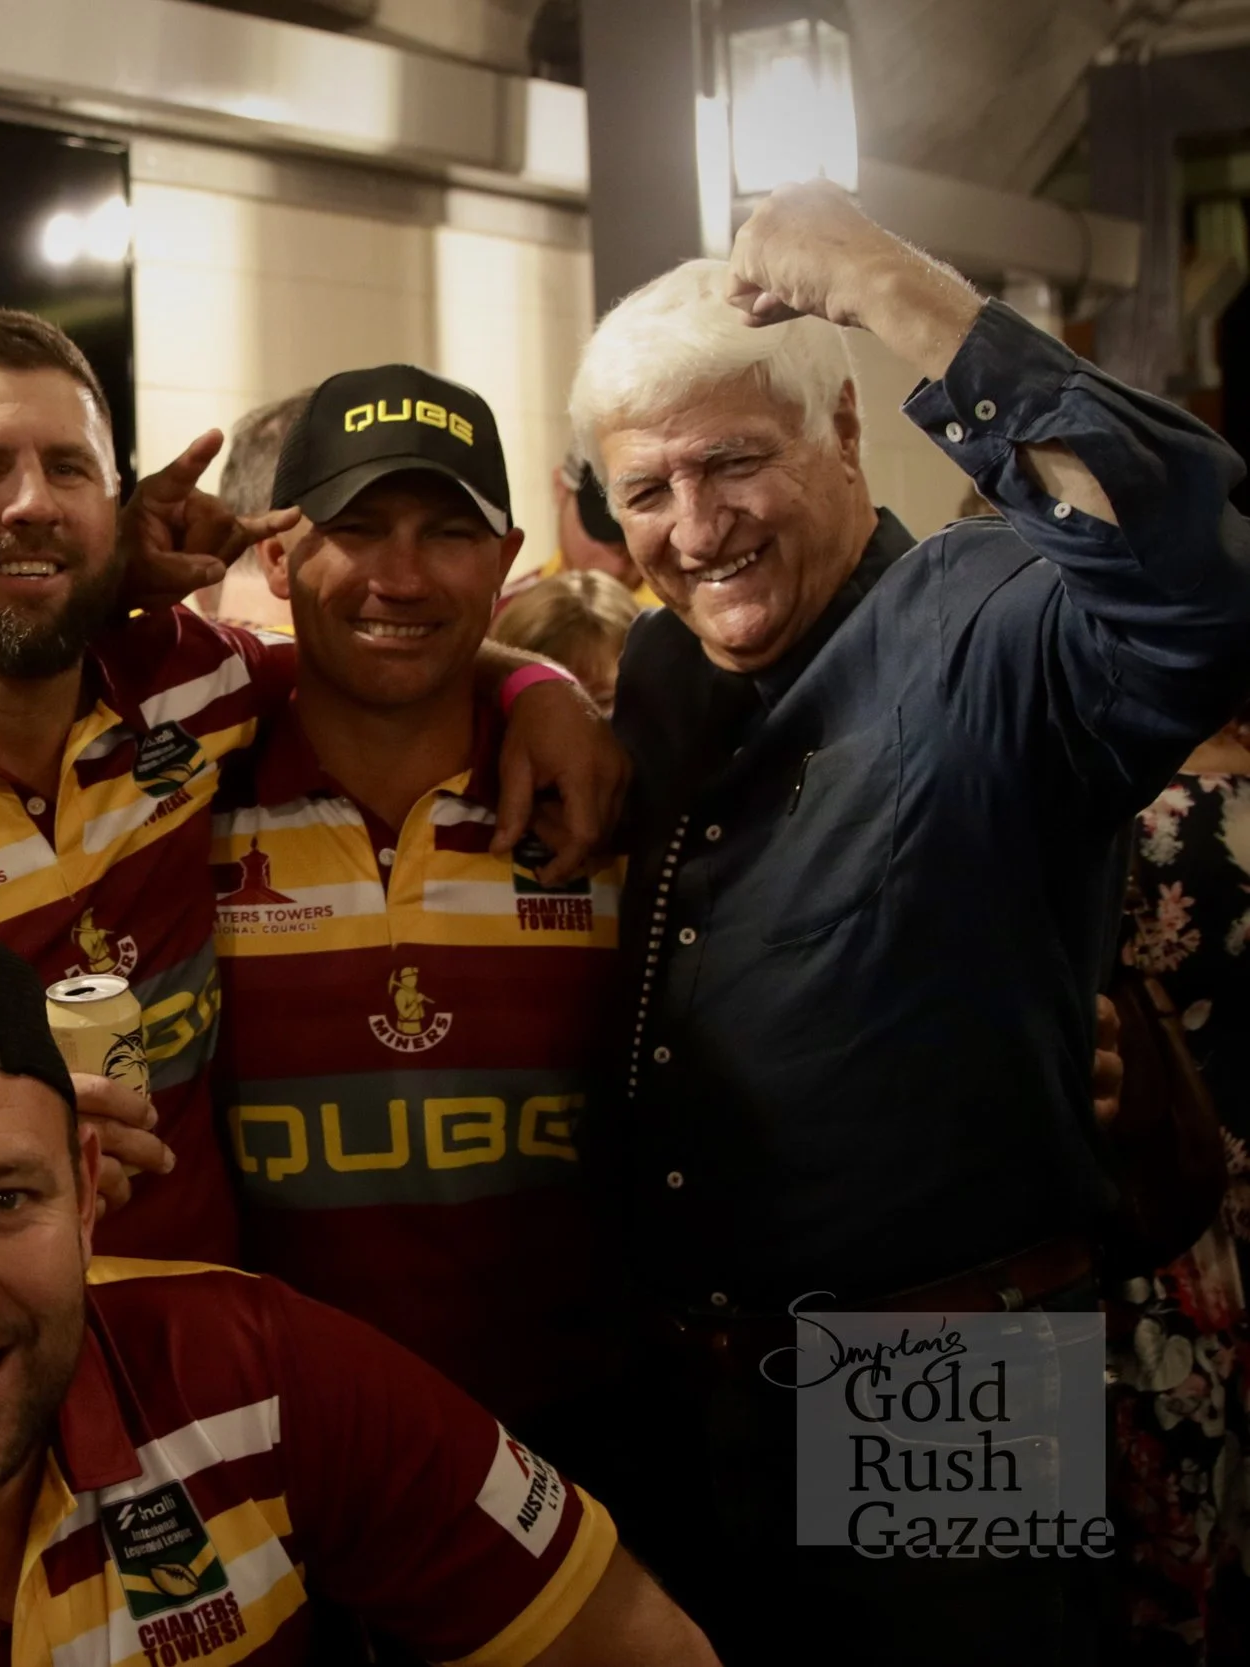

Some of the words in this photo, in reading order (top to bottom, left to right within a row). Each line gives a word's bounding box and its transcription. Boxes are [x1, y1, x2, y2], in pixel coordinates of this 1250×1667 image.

[345, 398, 474, 447] QUBE
[265, 905, 334, 922] TOWERS
[516, 898, 592, 914] CHARTERS
[262, 923, 318, 934] COUNCIL
[373, 1016, 448, 1050] MINERS
[228, 1093, 586, 1182] QUBE
[138, 1591, 239, 1649] CHARTERS
